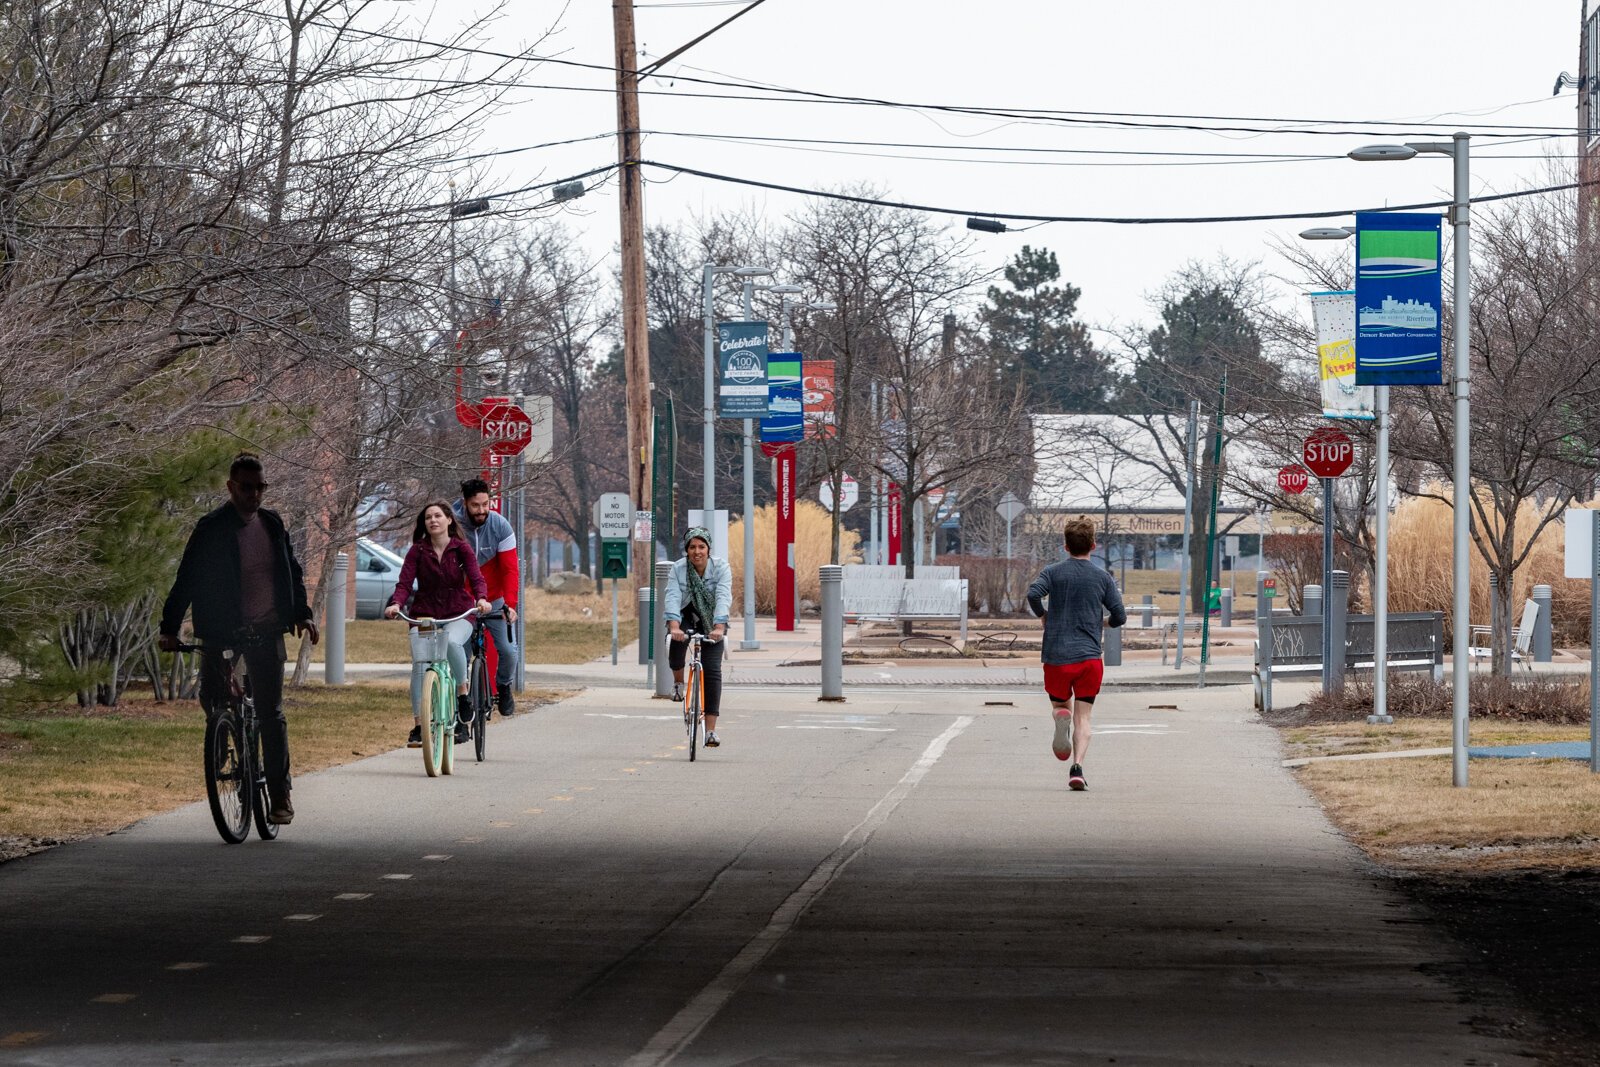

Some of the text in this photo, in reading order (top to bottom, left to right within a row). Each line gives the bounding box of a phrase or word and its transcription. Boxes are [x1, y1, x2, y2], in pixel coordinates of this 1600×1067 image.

[720, 334, 767, 352] Celebrate!
[735, 357, 752, 366] 100
[485, 421, 528, 440] STOP
[1307, 443, 1350, 461] STOP
[1280, 473, 1306, 485] STOP
[1130, 517, 1181, 530] Milliken
